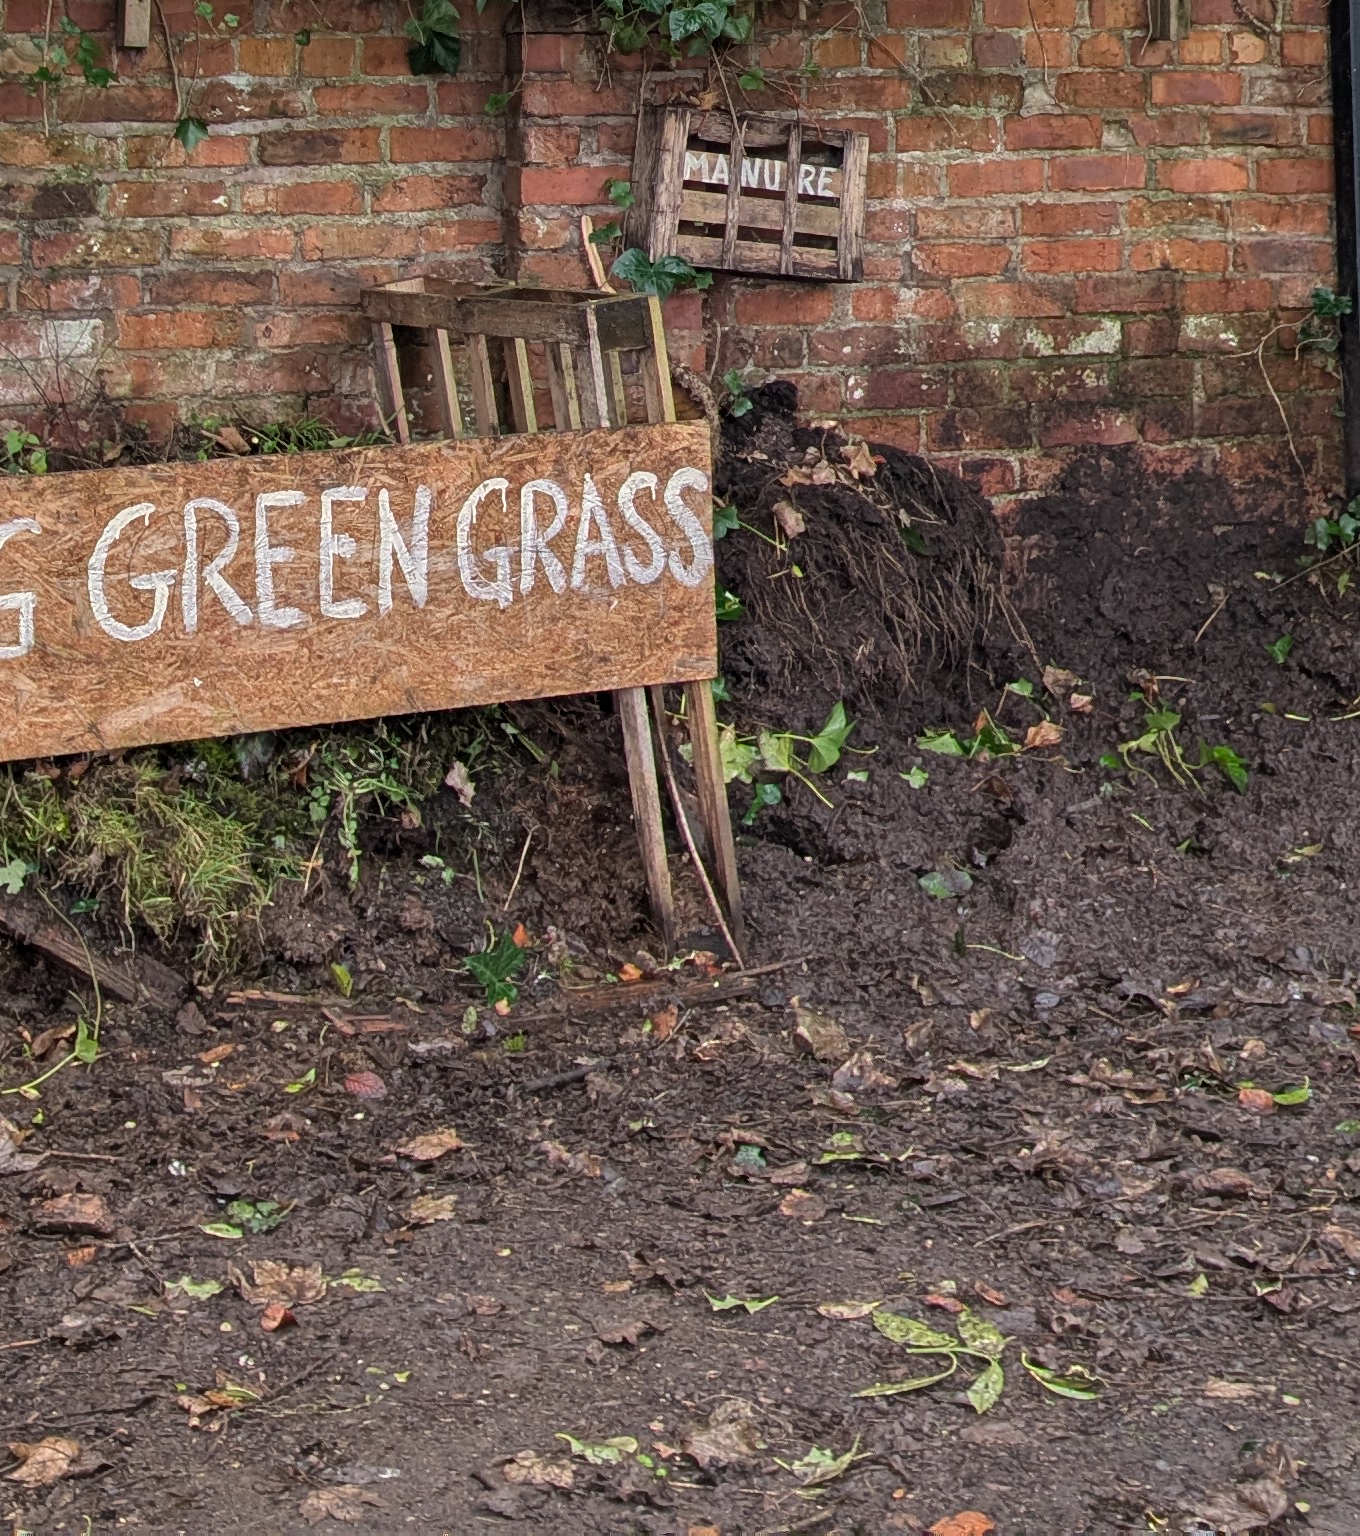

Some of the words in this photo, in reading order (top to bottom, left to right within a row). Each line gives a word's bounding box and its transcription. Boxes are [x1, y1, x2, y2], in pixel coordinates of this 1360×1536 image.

[683, 151, 838, 197] MANURE
[87, 484, 428, 642] GREEN
[456, 467, 714, 610] GRASS
